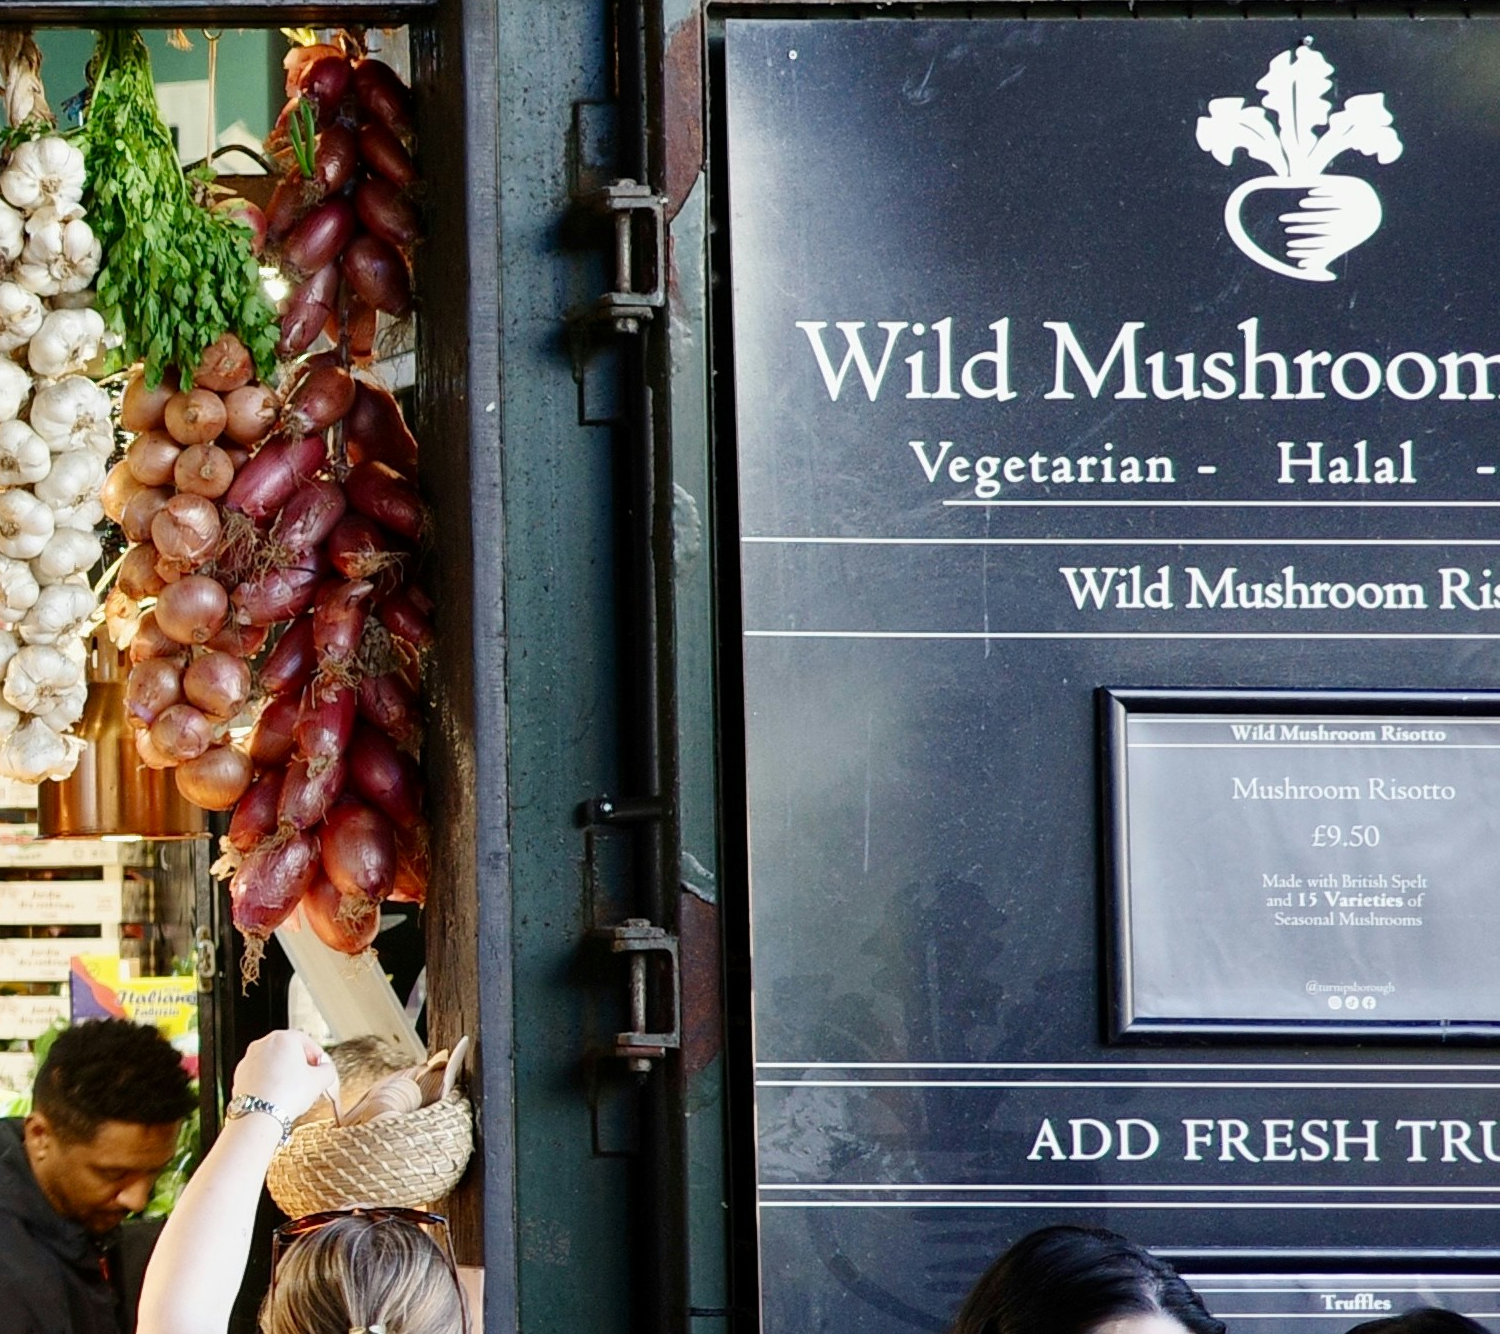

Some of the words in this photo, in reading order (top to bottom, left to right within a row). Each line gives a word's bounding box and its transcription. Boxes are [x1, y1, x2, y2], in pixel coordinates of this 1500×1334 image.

[794, 316, 1018, 402] Wild
[908, 440, 1176, 499] Vegetarian
[1277, 439, 1417, 484] Halal
[1058, 565, 1174, 610] Wild
[1184, 565, 1429, 609] Mushroom
[1230, 724, 1276, 741] Wild
[1279, 724, 1377, 741] Mushroom
[1381, 725, 1447, 742] Risotto
[1232, 776, 1361, 800] Mushroom
[1368, 777, 1456, 801] Risotto
[1311, 824, 1380, 847] £9.50
[1262, 873, 1303, 888] Made
[1307, 873, 1339, 888] with
[1342, 873, 1387, 888] British
[1391, 873, 1428, 894] Spelt
[1266, 892, 1293, 907] and
[1299, 892, 1318, 907] 15
[1323, 890, 1404, 908] Varieties
[1407, 892, 1426, 908] of
[1274, 911, 1329, 926] Seasonal
[1338, 911, 1423, 927] Mushrooms
[1305, 980, 1396, 996] @turnipsborough
[1026, 1118, 1160, 1161] ADD
[1181, 1119, 1380, 1163] FRESH
[1320, 1292, 1392, 1311] Truffles
